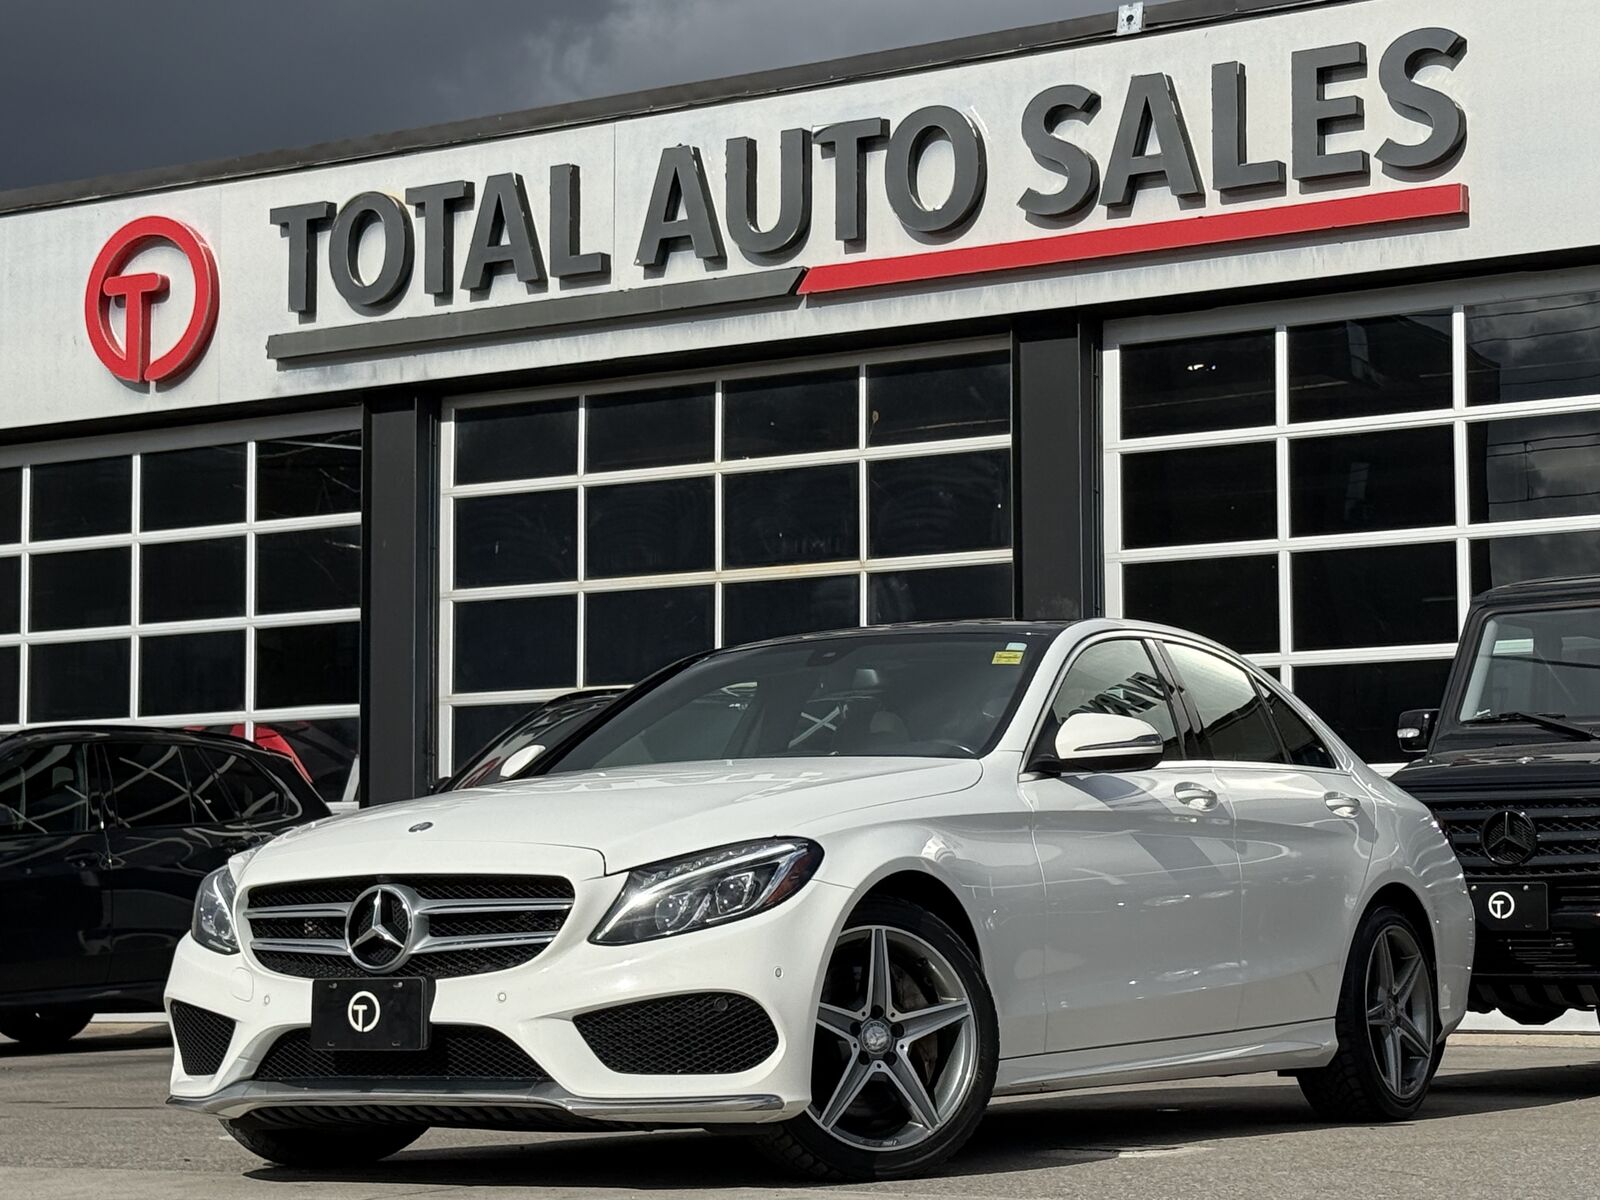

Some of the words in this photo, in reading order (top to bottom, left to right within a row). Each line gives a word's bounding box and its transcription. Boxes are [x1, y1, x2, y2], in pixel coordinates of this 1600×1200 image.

[270, 163, 611, 318] TOTAL
[635, 105, 988, 267] AUTO
[1016, 27, 1468, 217] SALES
